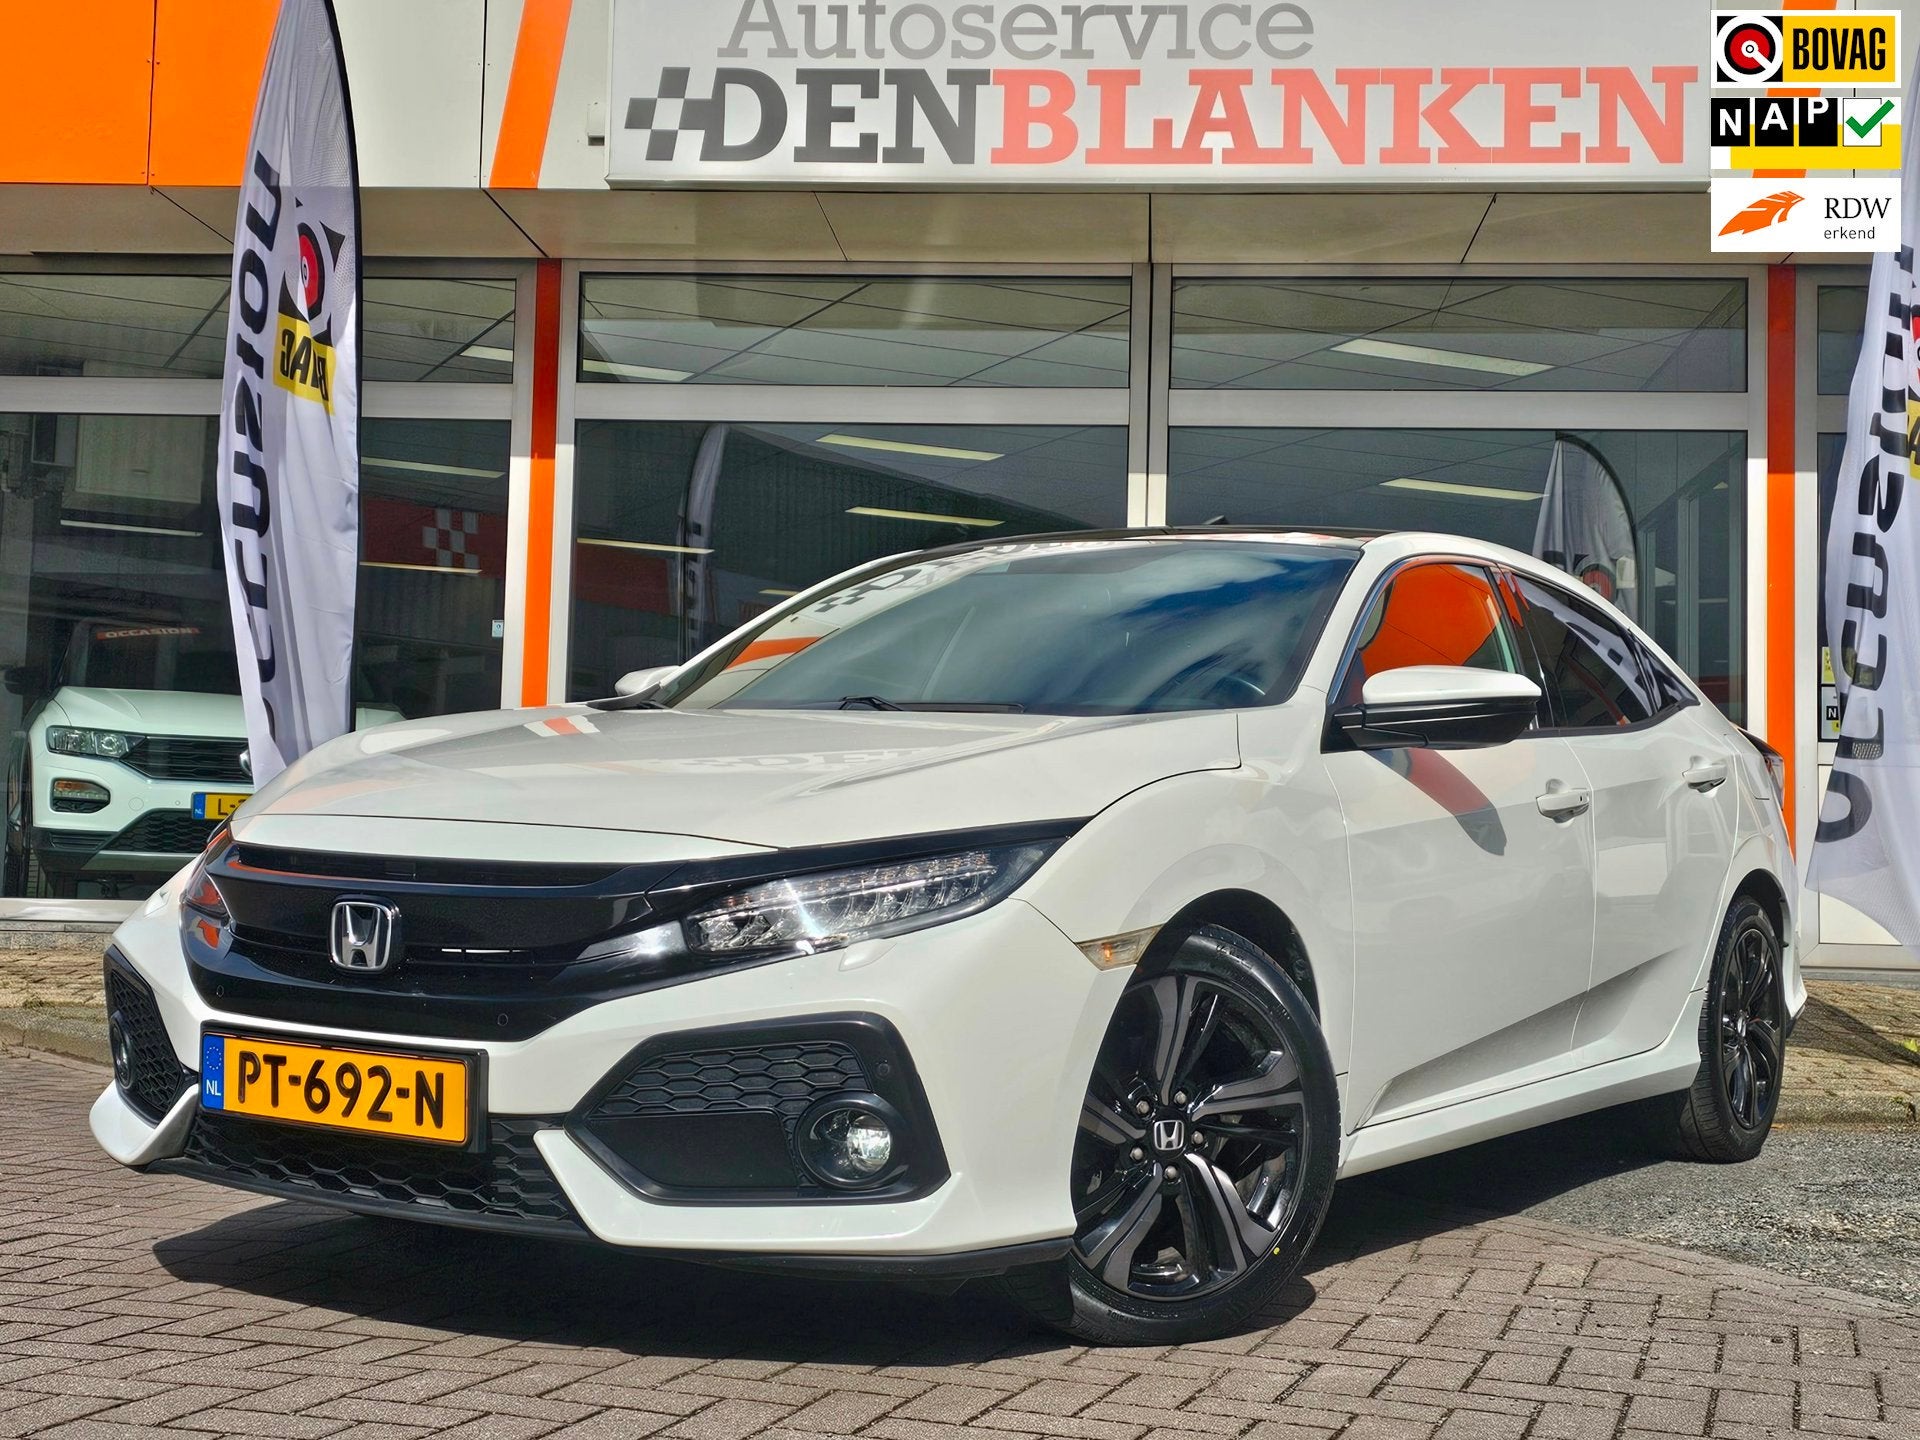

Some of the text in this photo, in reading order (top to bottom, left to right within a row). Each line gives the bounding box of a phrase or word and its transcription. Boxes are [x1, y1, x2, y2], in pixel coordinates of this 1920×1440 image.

[716, 0, 1315, 60] Autoservice
[105, 626, 195, 639] OCCASION
[206, 1079, 222, 1096] NL
[237, 1050, 445, 1129] PT-692-N
